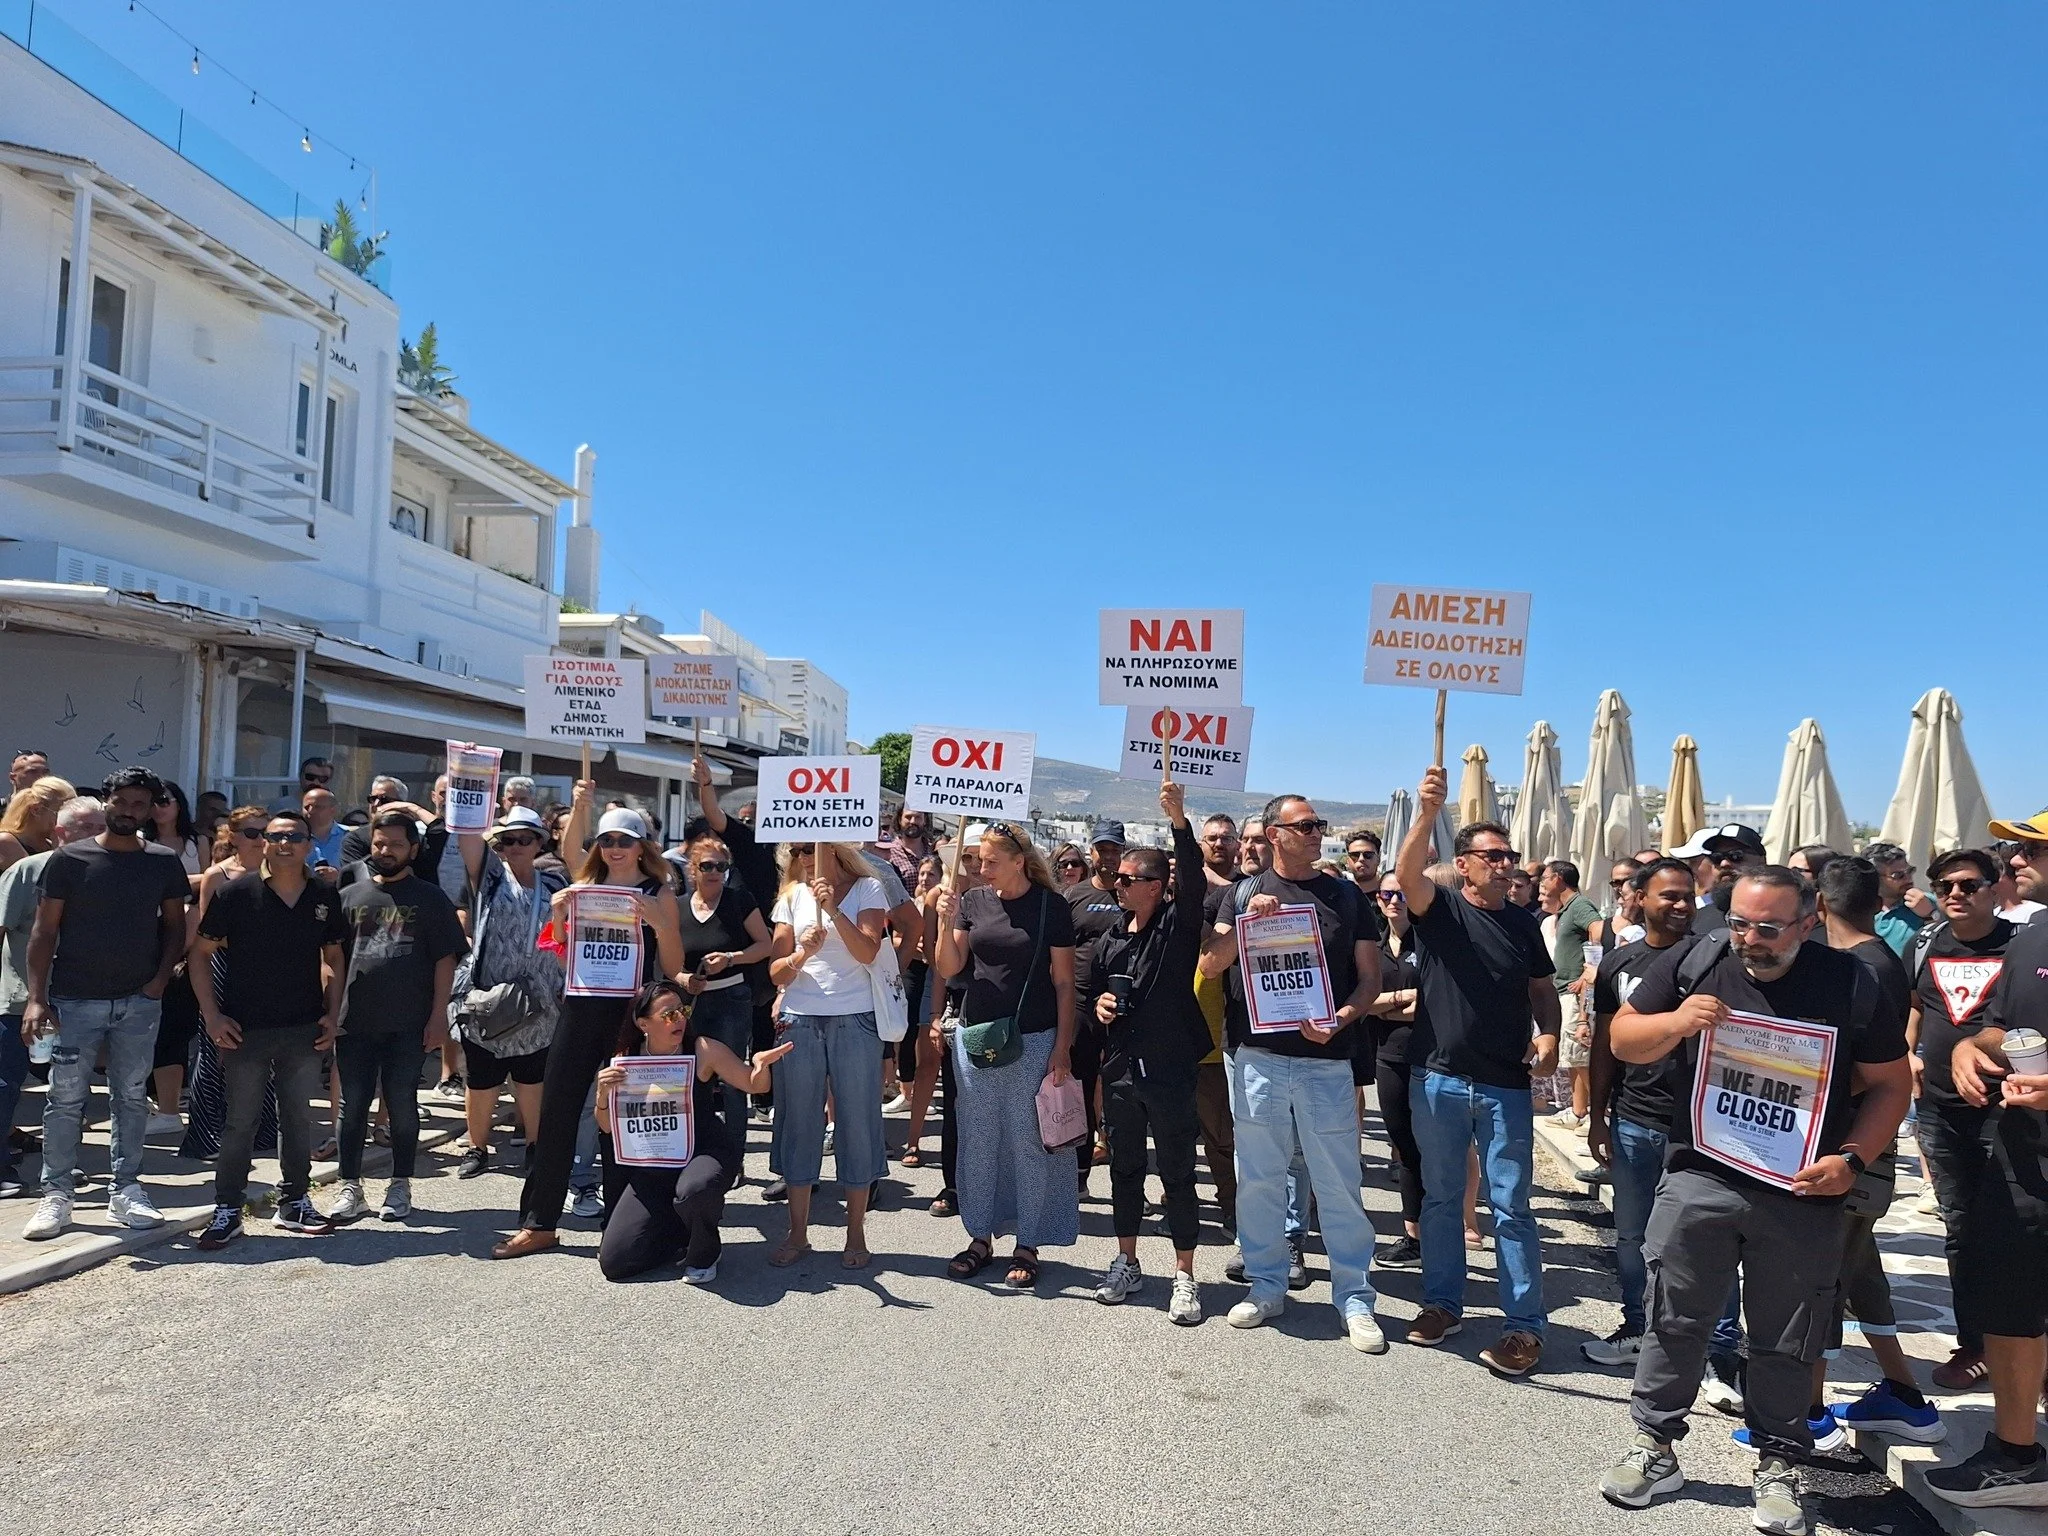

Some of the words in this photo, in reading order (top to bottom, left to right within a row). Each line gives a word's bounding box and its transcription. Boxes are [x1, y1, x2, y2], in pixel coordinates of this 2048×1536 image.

[1389, 592, 1507, 626] ΑΜΕΣΗ
[1130, 619, 1212, 652] ΝΑΙ
[1371, 629, 1523, 656] ΑΔΕΙΟΔΟΤΗΣΗ
[552, 660, 616, 672] ΙΣΟΤΙΜΙΑ
[673, 662, 713, 675] ΖΗΤΑΜΕ
[1105, 657, 1126, 669] ΝΑ
[1130, 657, 1237, 670] ΠΛΗΡΩΣΟΥΜΕ
[1395, 659, 1421, 678] ΣΕ
[1427, 661, 1500, 684] ΟΛΟΥΣ
[545, 673, 569, 684] ΓΙΑ
[574, 675, 623, 687] ΟΛΟΥΣ
[654, 677, 731, 690] ΑΠΟΚΑΤΑΣΤΑΣΗ
[1123, 675, 1145, 688] ΤΑ
[1149, 676, 1219, 689] ΝΟΜΙΜΑ
[554, 685, 616, 698] ΛΙΜΕΝΙΚΟ
[662, 692, 728, 705] ΔΙΚΑΙΟΣΥΝΗΣ
[569, 699, 602, 710] ΕΤΑΔ
[563, 712, 608, 724] ΔΗΜΟΣ
[550, 725, 624, 738] ΚΤΗΜΑΤΙΚΗ
[1151, 709, 1228, 746] ΟΧΙ
[931, 737, 1004, 771] ΟΧΙ
[1129, 740, 1163, 755] ΣΤΙΣ
[1168, 744, 1242, 763] ΠΟΙΝΙΚΕΣ
[1152, 760, 1215, 776] ΔΩΞΕΙΣ
[787, 767, 850, 794] ΟΧΙ
[914, 774, 942, 787] ΣΤΑ
[945, 777, 1024, 795] ΠΑΡΑΛΟΓΑ
[772, 799, 817, 811] ΣΤΟΝ
[822, 798, 865, 811] 5ΕΤΗ
[929, 792, 1004, 811] ΠΡΟΣΤΙΜΑ
[761, 815, 874, 829] ΑΠΟΚΛΕΙΣΜΟ
[584, 926, 604, 943] WE
[607, 927, 631, 944] ARE
[583, 943, 630, 961] CLOSED
[1257, 954, 1280, 973] WE
[1284, 951, 1312, 971] ARE
[1261, 970, 1314, 992] CLOSED
[1939, 964, 1991, 980] GUESS
[1718, 1023, 1772, 1041] ΚΛΕΙΝΟΥΜΕ
[1773, 1034, 1797, 1046] ΠΡΙΝ
[1743, 1036, 1790, 1053] ΚΛΕΙΣΟΥΝ
[1722, 1067, 1755, 1096] WE
[1760, 1077, 1802, 1109] ARE
[626, 1101, 647, 1118] WE
[651, 1100, 678, 1116] ARE
[1716, 1091, 1797, 1133] CLOSED
[627, 1116, 678, 1134] CLOSED
[1728, 1120, 1738, 1128] WE
[1738, 1121, 1749, 1131] ARE
[1749, 1124, 1757, 1132] ON
[1757, 1126, 1776, 1138] STRIKE
